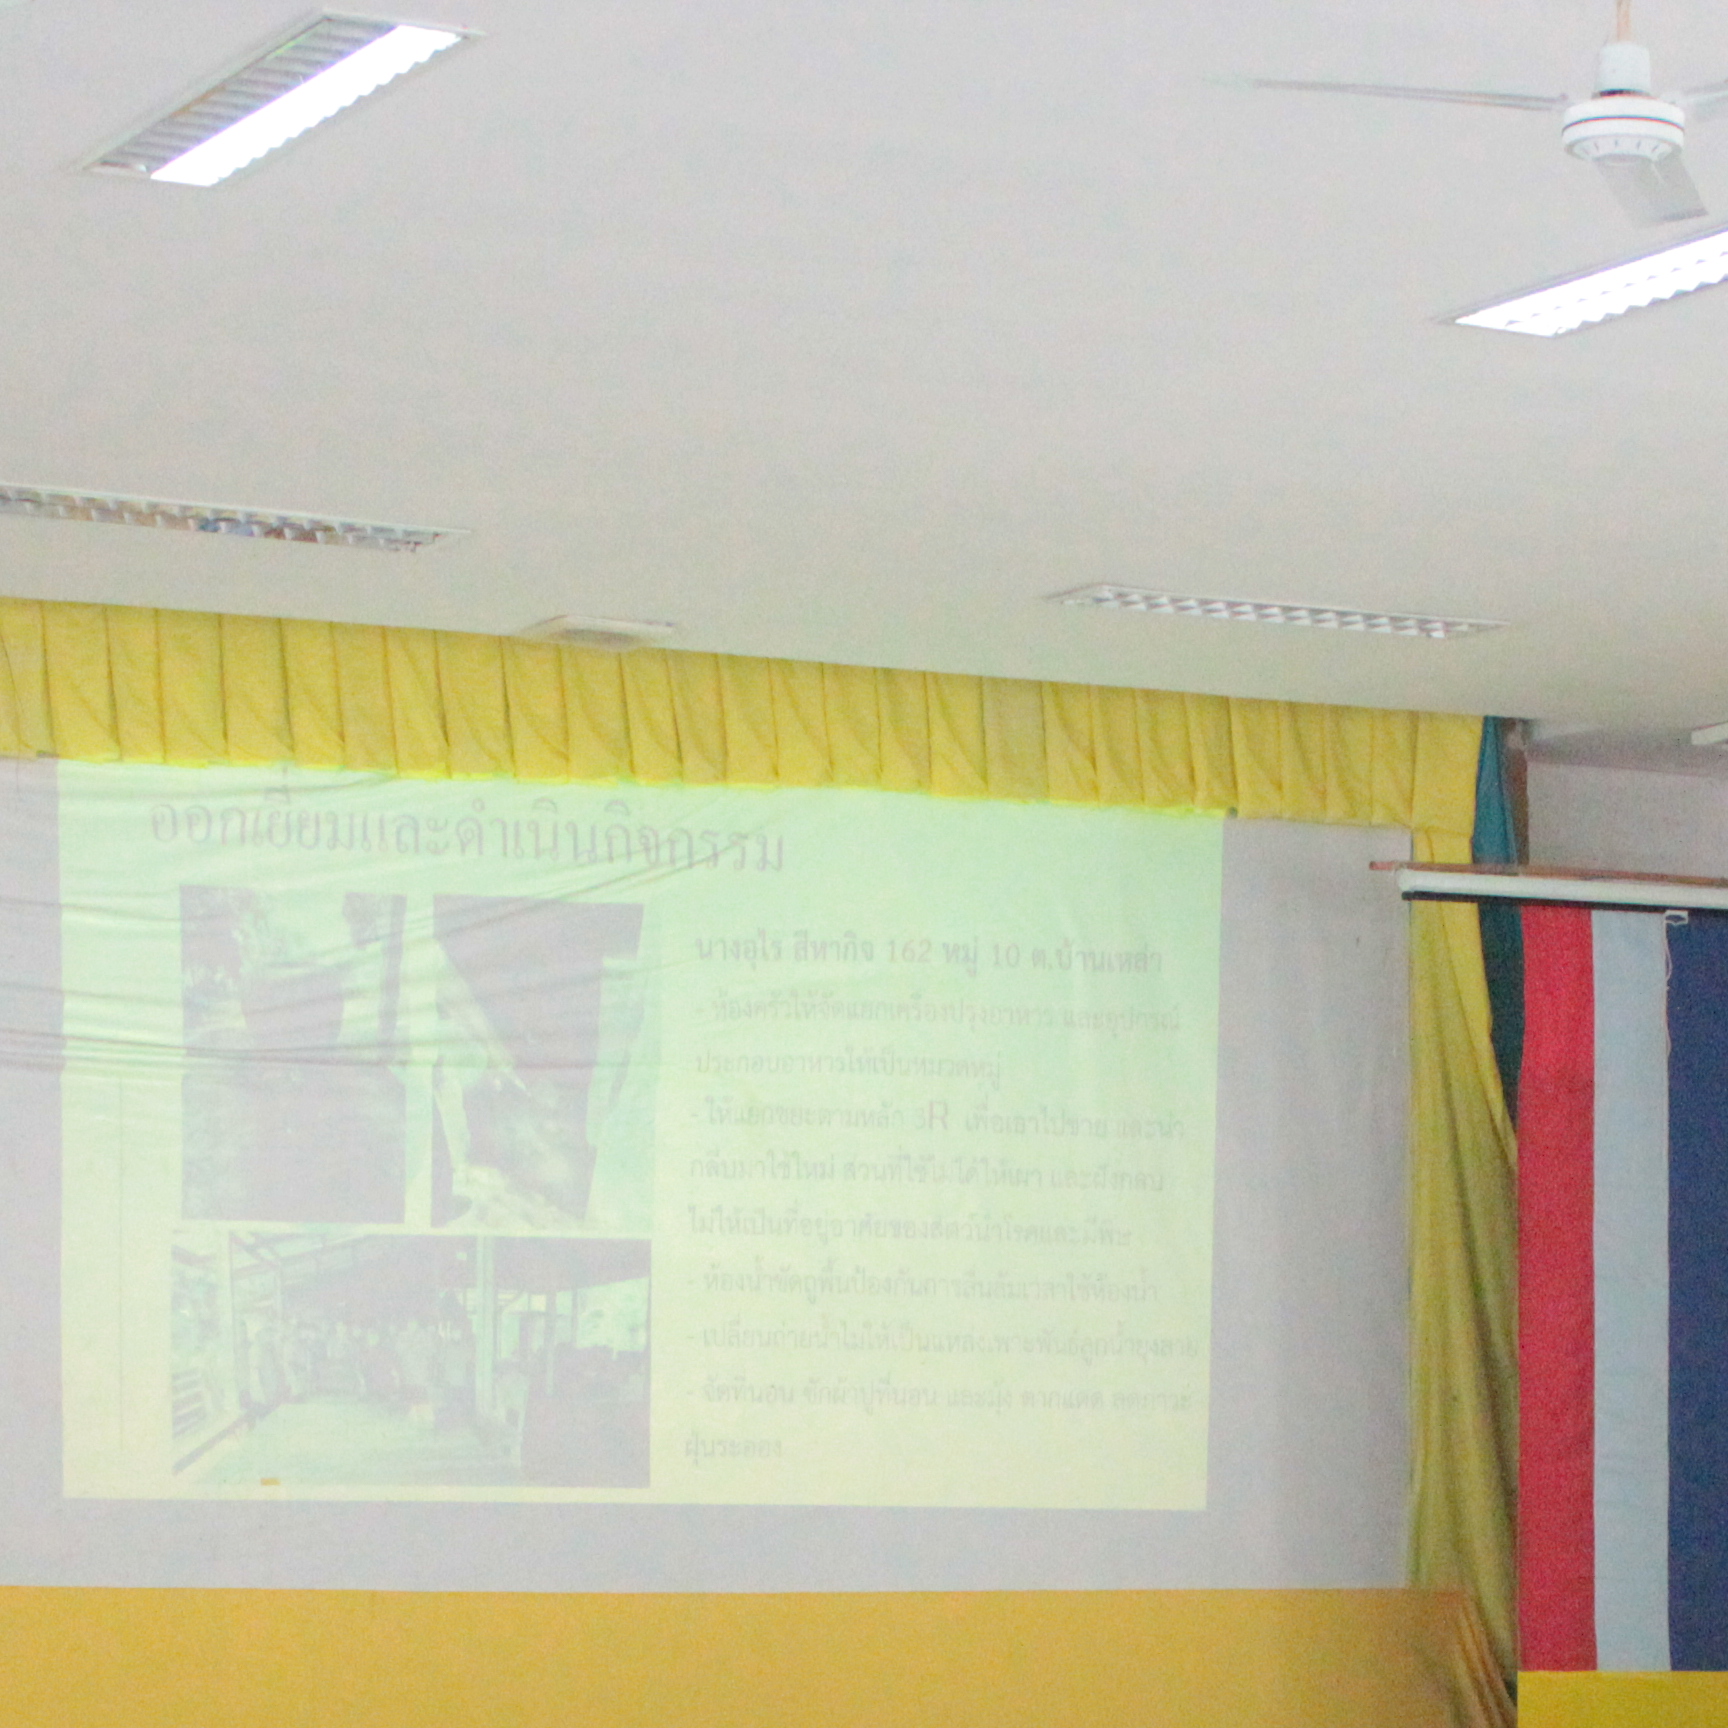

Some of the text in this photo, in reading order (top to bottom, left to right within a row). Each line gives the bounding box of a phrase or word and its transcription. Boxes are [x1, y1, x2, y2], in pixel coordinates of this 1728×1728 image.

[151, 766, 785, 871] ออกเยี่ยมและดำเนินกิจกรรม
[695, 927, 782, 970] นางอุไร
[886, 938, 933, 964] 162
[942, 936, 979, 978] หมู่
[991, 942, 1022, 970] 10
